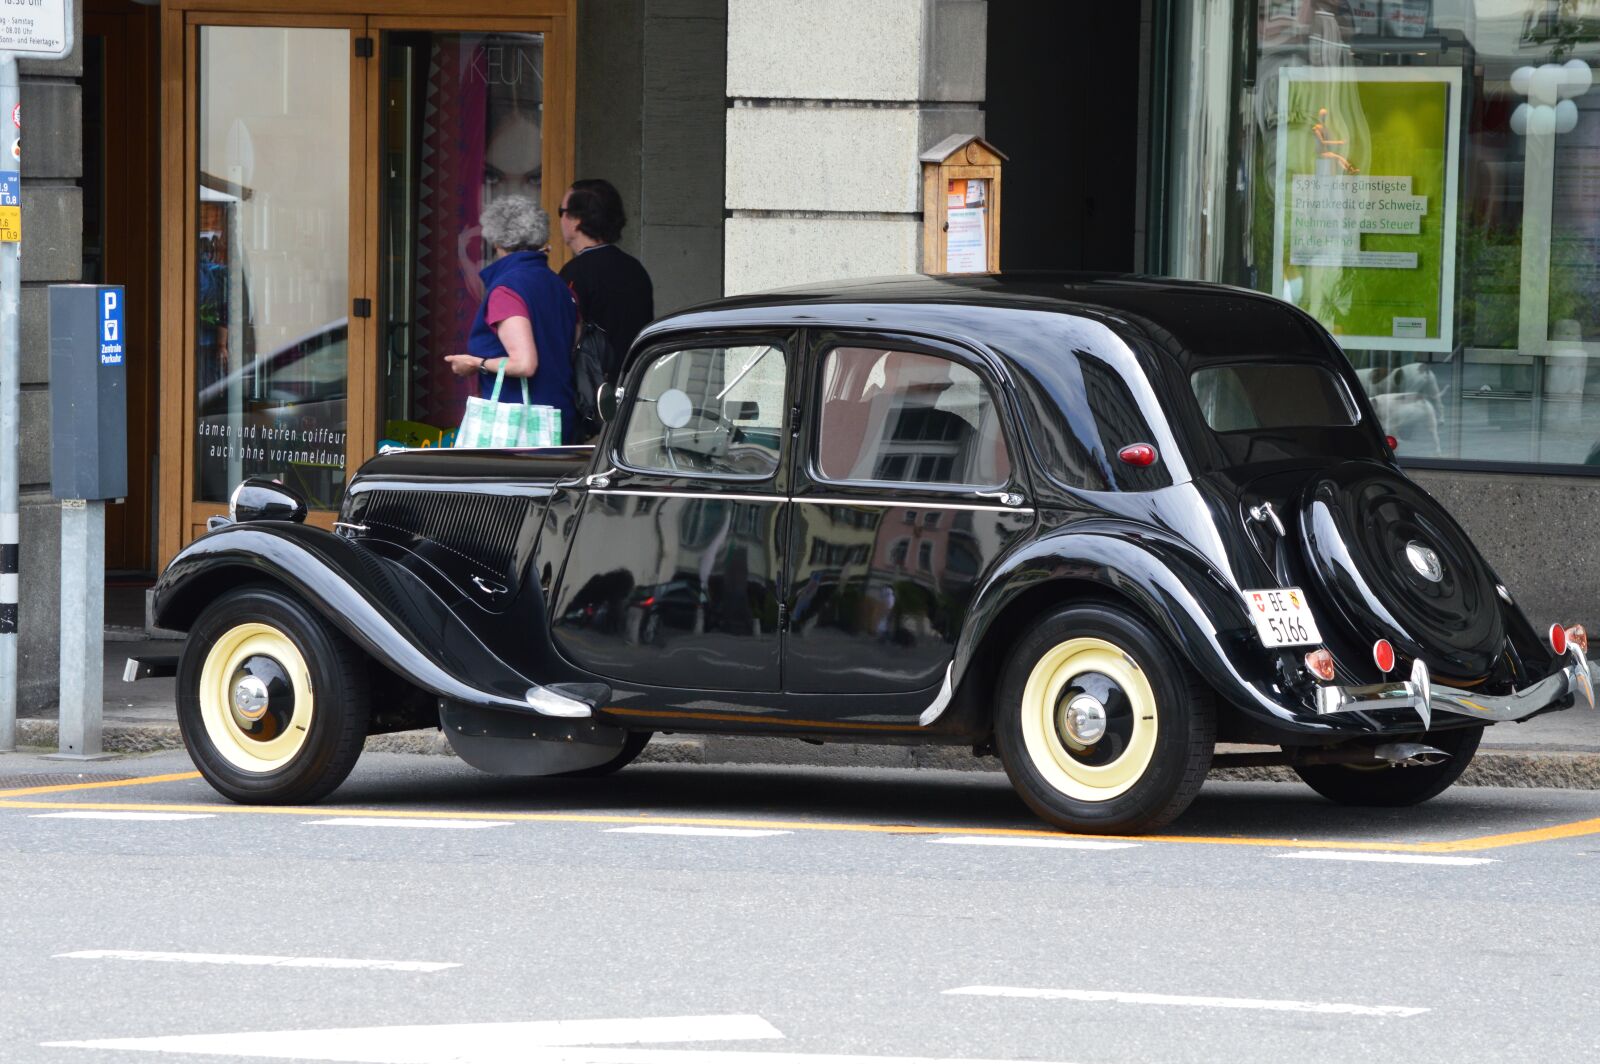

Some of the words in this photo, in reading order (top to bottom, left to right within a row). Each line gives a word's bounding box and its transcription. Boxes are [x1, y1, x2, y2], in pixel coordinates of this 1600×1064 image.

[11, 17, 34, 26] Samstag
[23, 27, 33, 35] Uhr
[1296, 179, 1320, 191] 5,9%
[1332, 179, 1349, 190] der
[1351, 179, 1407, 194] günstigste
[1295, 198, 1356, 211] Privatkredit
[1358, 199, 1376, 210] der
[1378, 199, 1424, 211] Schweiz.
[1342, 217, 1357, 229] Sie
[1359, 218, 1377, 229] das
[1379, 218, 1415, 230] Steuer
[104, 291, 117, 320] P
[199, 420, 231, 436] damen
[237, 423, 256, 439] und
[261, 425, 297, 441] herren
[302, 428, 346, 444] coiffeur
[210, 444, 234, 458] auch
[240, 444, 265, 460] ohne
[270, 448, 346, 469] voranmeldung
[1267, 592, 1288, 612] BE
[1267, 616, 1309, 643] 5166
